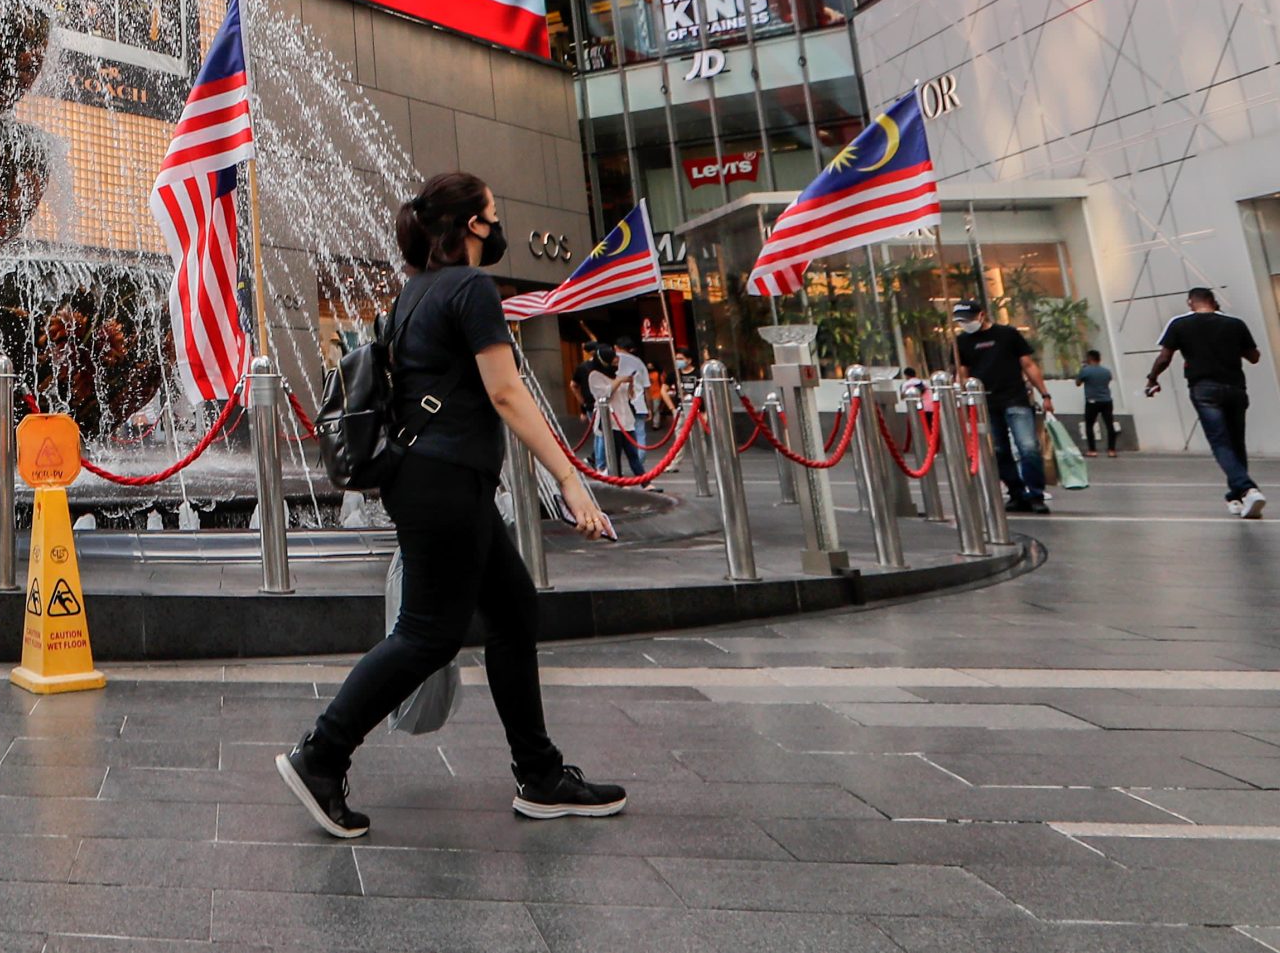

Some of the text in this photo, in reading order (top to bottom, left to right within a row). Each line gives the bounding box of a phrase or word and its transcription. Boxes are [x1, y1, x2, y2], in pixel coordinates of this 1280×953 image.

[667, 11, 770, 41] OF TAINERS
[685, 48, 726, 81] JD
[529, 230, 572, 263] COS
[47, 639, 87, 650] WET FLOOR
[50, 629, 82, 640] CAUTION
